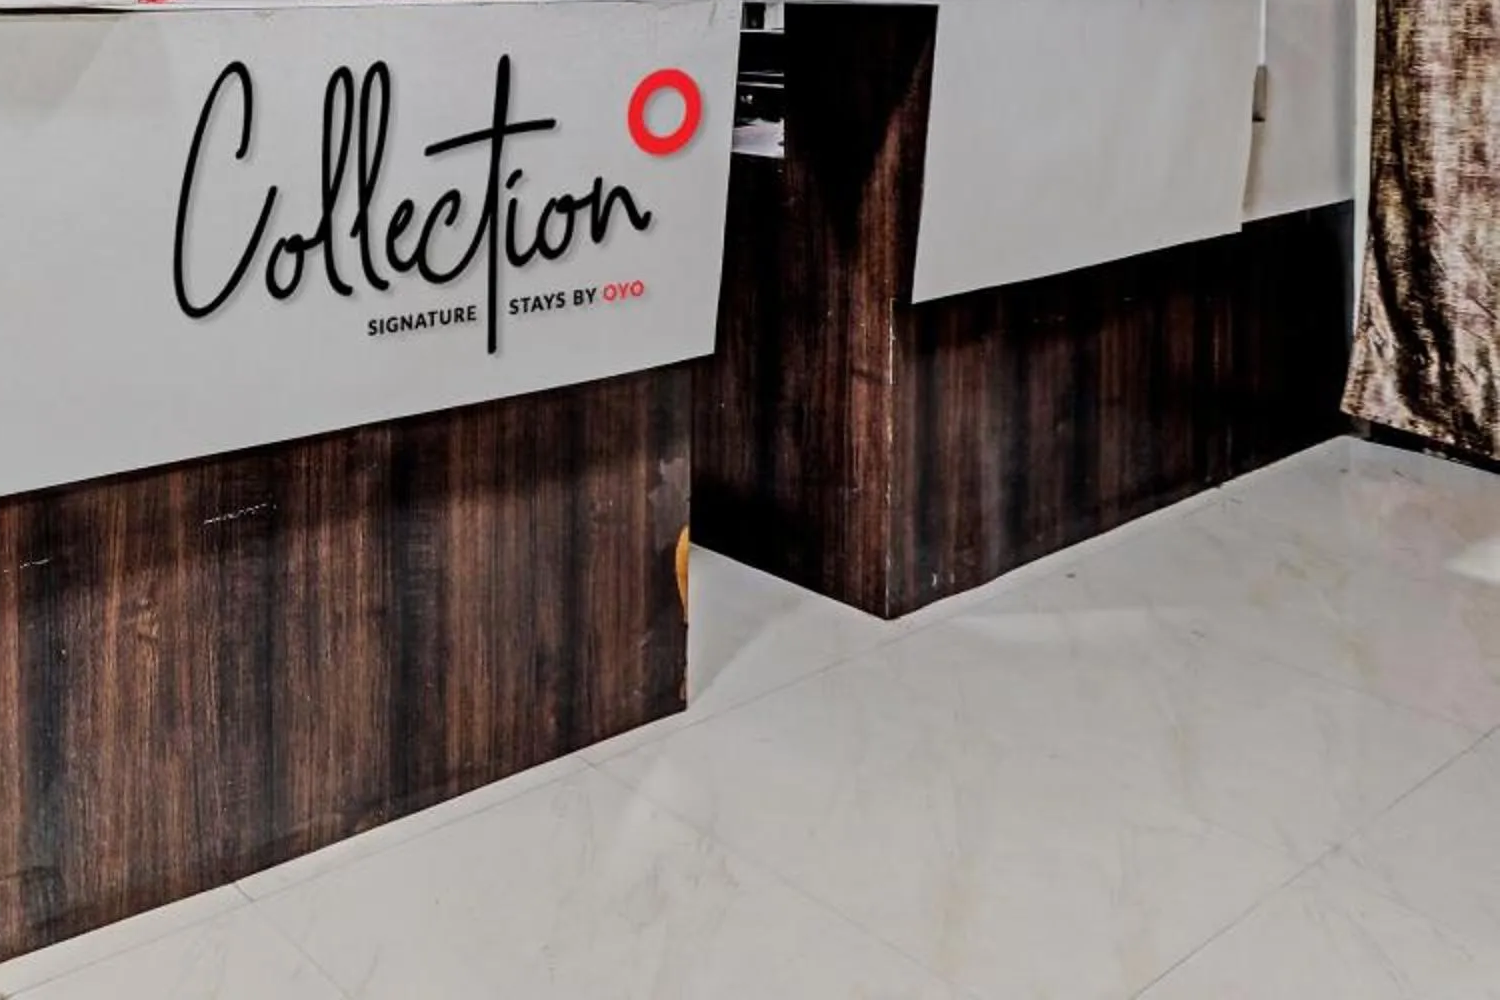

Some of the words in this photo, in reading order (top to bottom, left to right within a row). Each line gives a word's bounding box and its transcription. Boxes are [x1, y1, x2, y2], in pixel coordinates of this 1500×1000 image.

[173, 53, 653, 355] Collection
[367, 304, 478, 337] SIGNATURE
[508, 291, 567, 316] STAYS
[572, 286, 598, 308] BY
[602, 279, 645, 302] OYO
